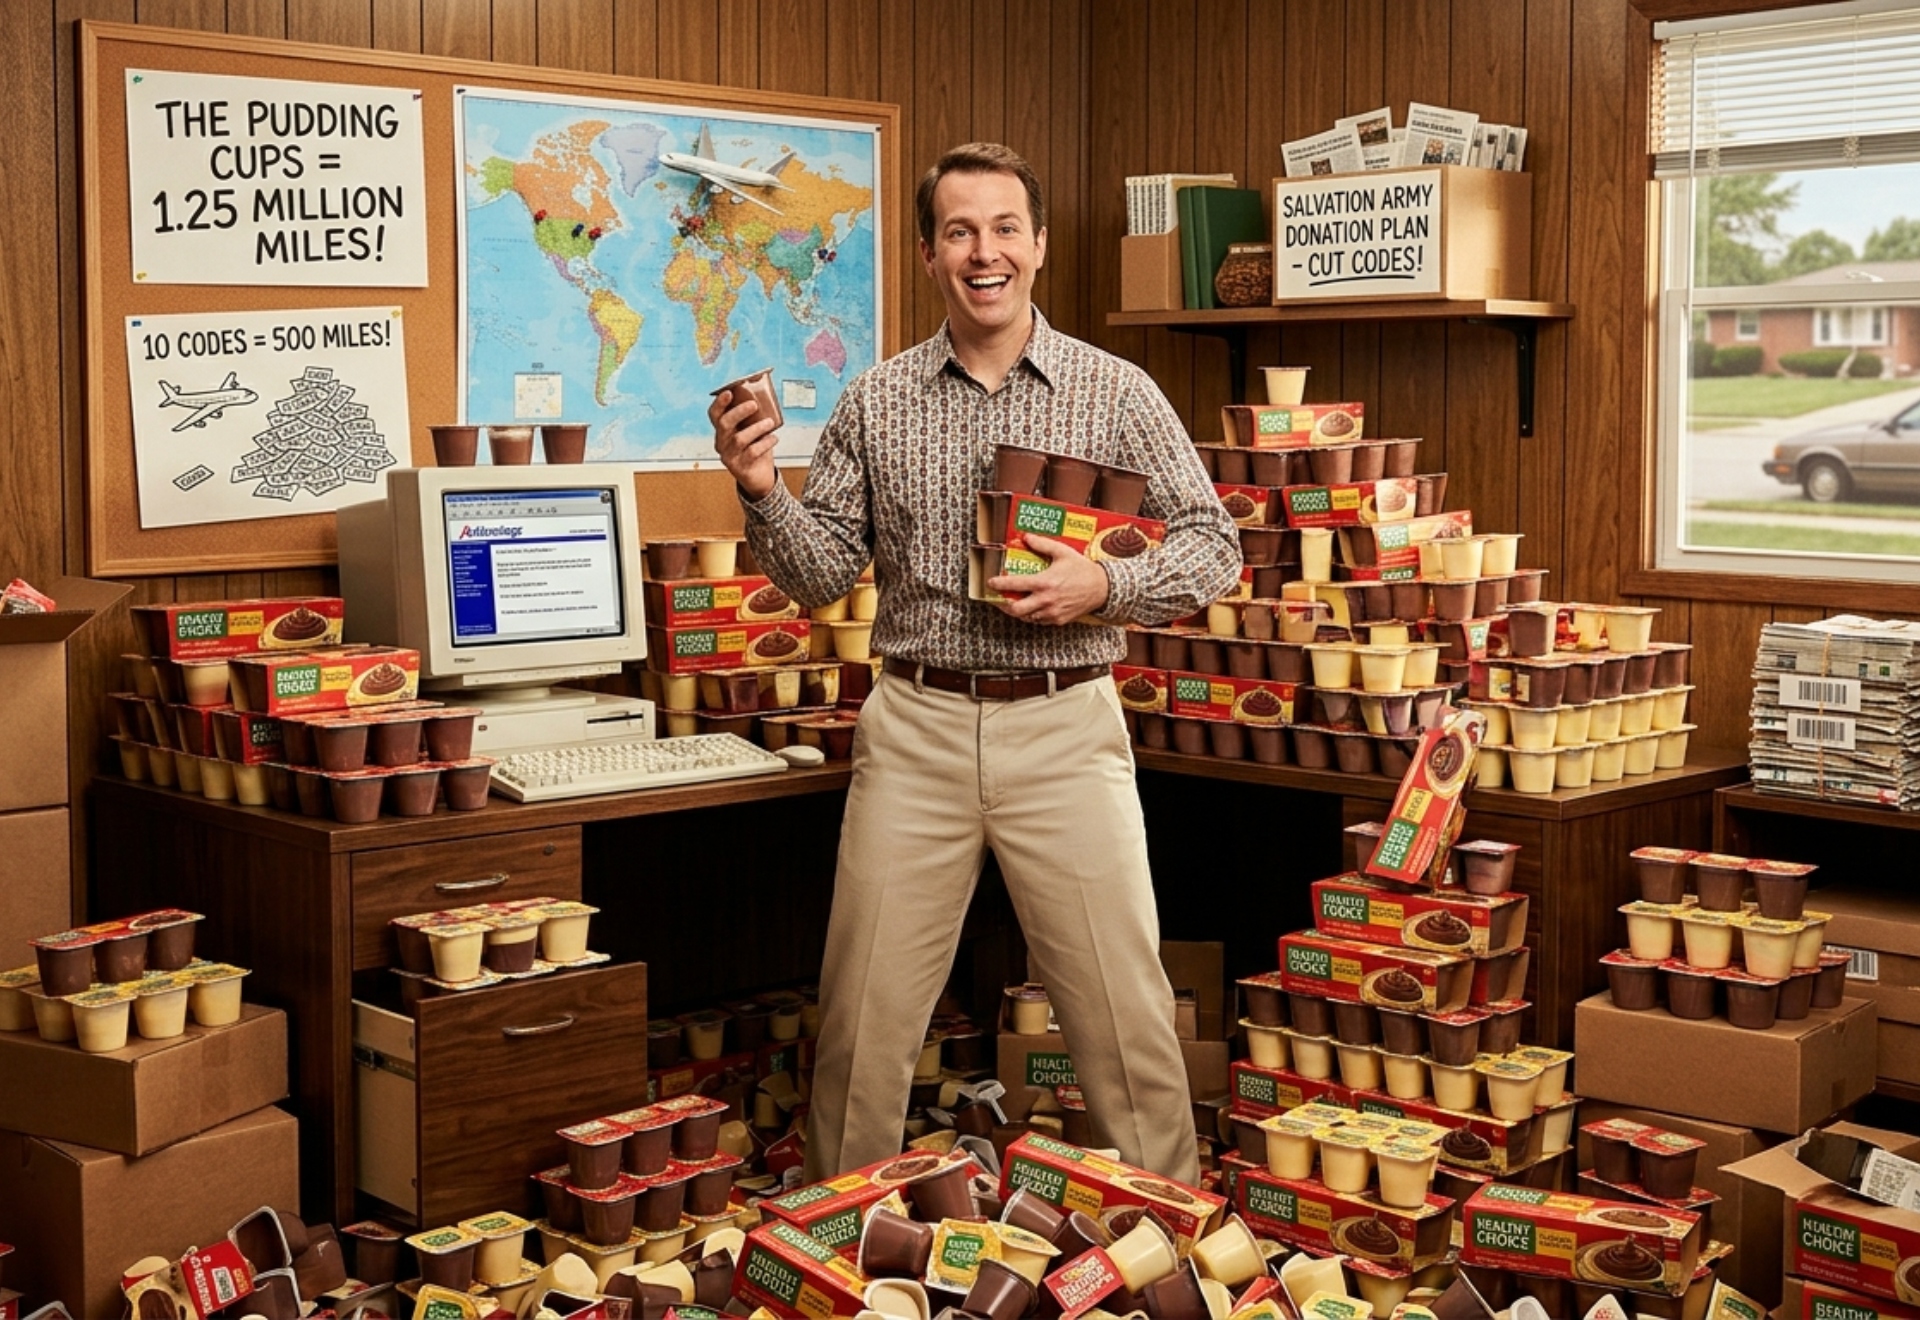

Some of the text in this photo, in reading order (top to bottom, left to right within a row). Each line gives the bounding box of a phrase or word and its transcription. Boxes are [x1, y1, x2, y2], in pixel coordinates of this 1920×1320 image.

[155, 100, 399, 139] THE PUDDING
[210, 144, 341, 181] CUPS =
[153, 185, 403, 234] 1.25 MILLION
[1283, 183, 1433, 219] SALVATION ARMY
[256, 224, 385, 265] MILES!
[1286, 214, 1429, 248] DONATION PLAN
[1308, 250, 1345, 277] CUT
[1351, 245, 1423, 274] CODES!
[143, 319, 390, 360] 10 CODES = 500 MILES!
